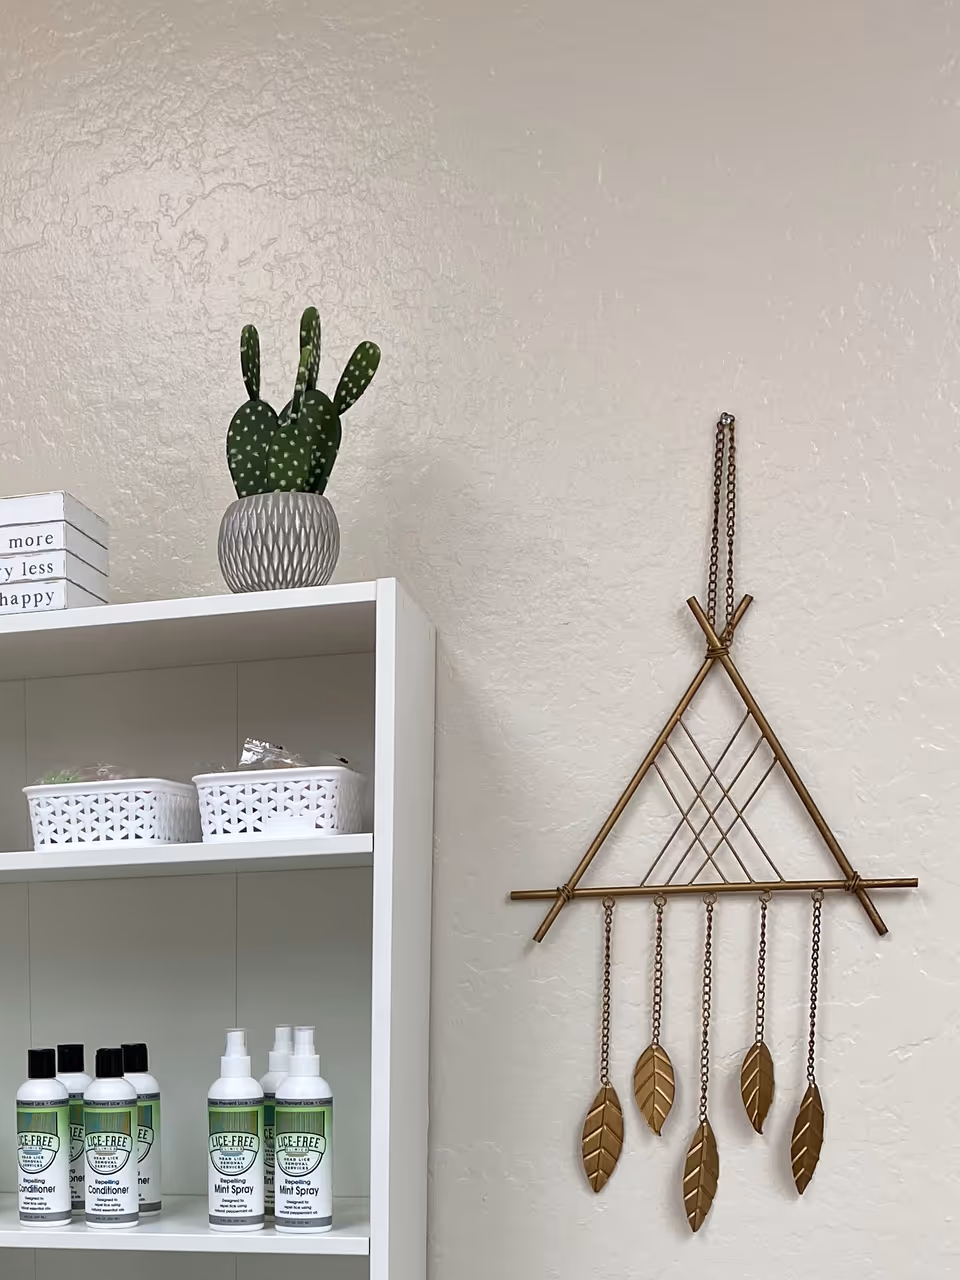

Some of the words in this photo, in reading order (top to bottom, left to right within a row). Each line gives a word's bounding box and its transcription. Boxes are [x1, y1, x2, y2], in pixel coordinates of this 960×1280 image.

[9, 534, 54, 549] more
[22, 562, 54, 576] less
[0, 591, 55, 609] happy
[87, 1136, 127, 1147] LICE-FREE
[211, 1135, 254, 1148] LICE-FREE
[277, 1136, 320, 1148] LICE-FREE
[88, 1185, 129, 1194] Conditioner
[214, 1184, 229, 1193] Mint
[231, 1185, 254, 1196] Spray
[280, 1185, 294, 1195] Mint
[296, 1186, 319, 1197] Spray
